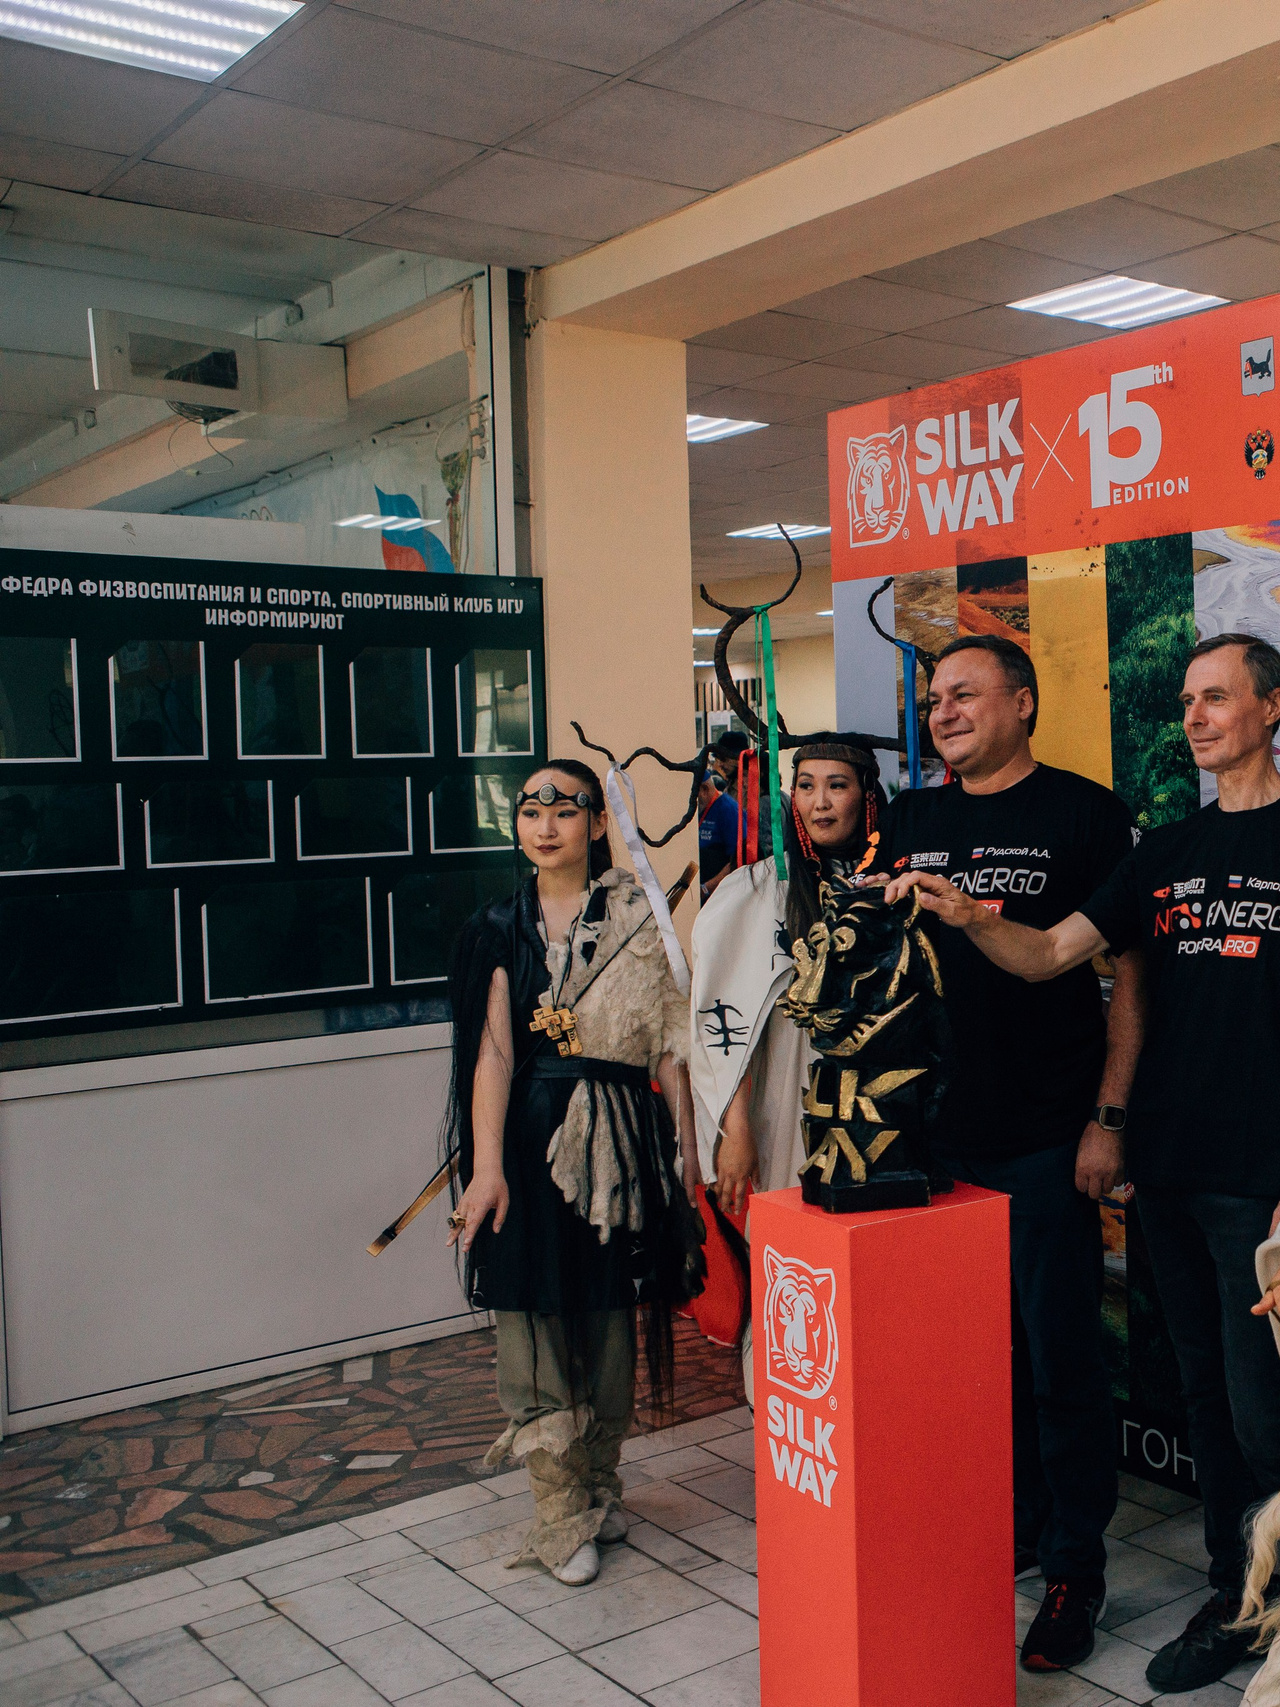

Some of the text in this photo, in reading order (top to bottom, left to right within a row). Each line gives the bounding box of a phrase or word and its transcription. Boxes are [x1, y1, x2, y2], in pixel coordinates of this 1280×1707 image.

[915, 397, 1024, 475] SILK
[916, 463, 1024, 536] WAY
[1112, 476, 1190, 505] EDITION
[0, 576, 524, 614] ФЕДРА ФИЗВОСПИТАНИЯ И СПОРТА, СПОРТИВНЫЙ КЛУБ ИГУ
[205, 608, 345, 630] ИНФОРМИРУЮТ
[910, 851, 950, 864] 玉柴动力
[767, 1394, 839, 1467] SILK
[768, 1436, 839, 1509] WAY
